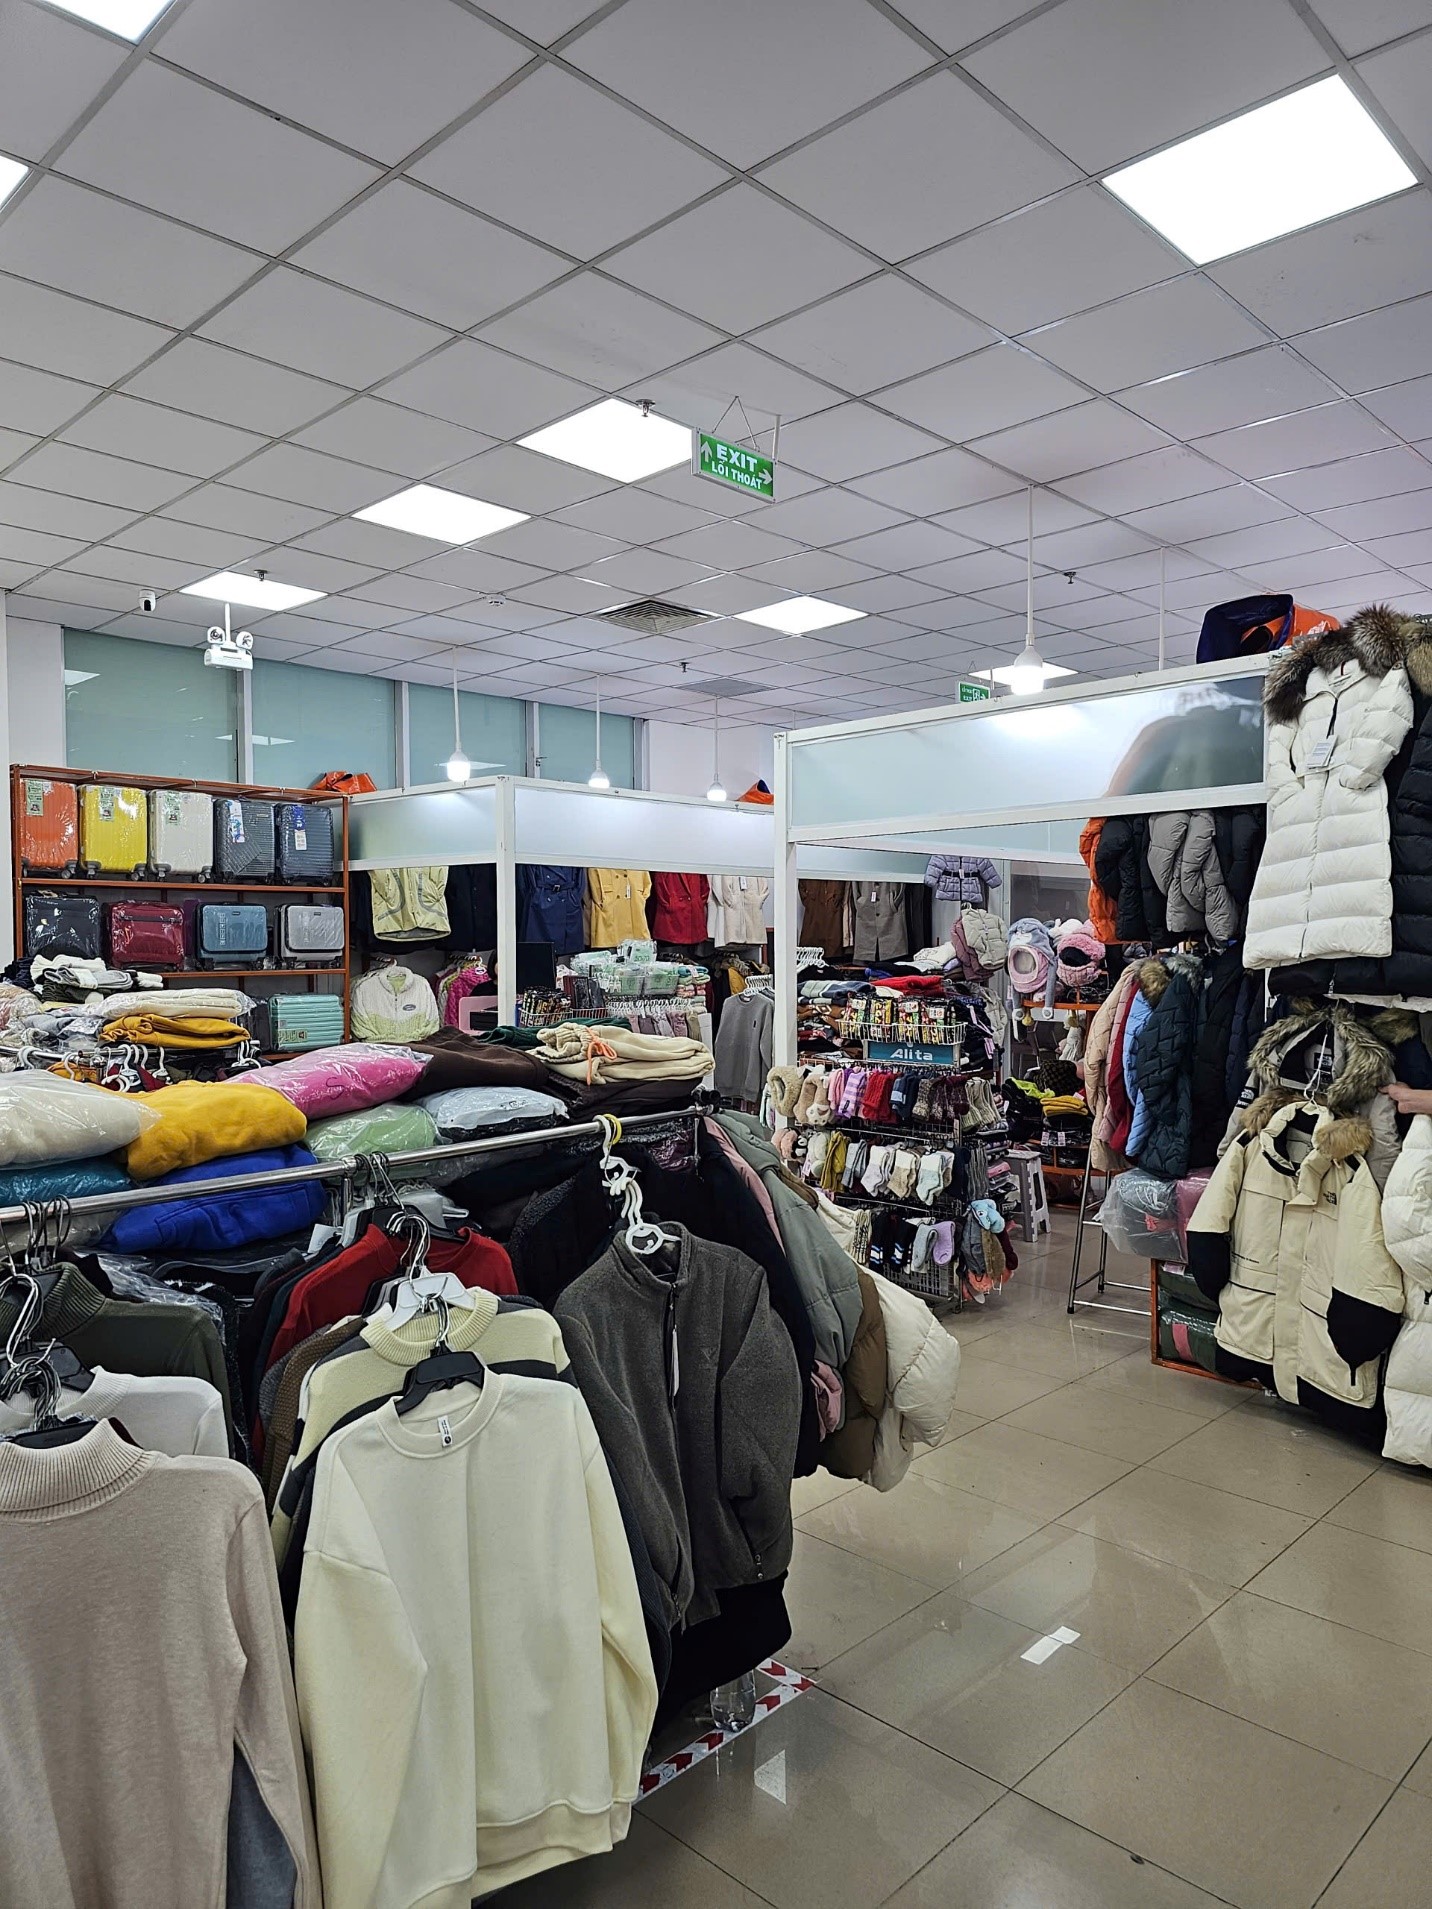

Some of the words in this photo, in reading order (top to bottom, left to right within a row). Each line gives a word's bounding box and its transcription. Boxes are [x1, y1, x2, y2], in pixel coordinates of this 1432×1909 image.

[717, 444, 758, 472] EXIT
[731, 469, 762, 489] THOÁT
[890, 1048, 933, 1061] Alita
